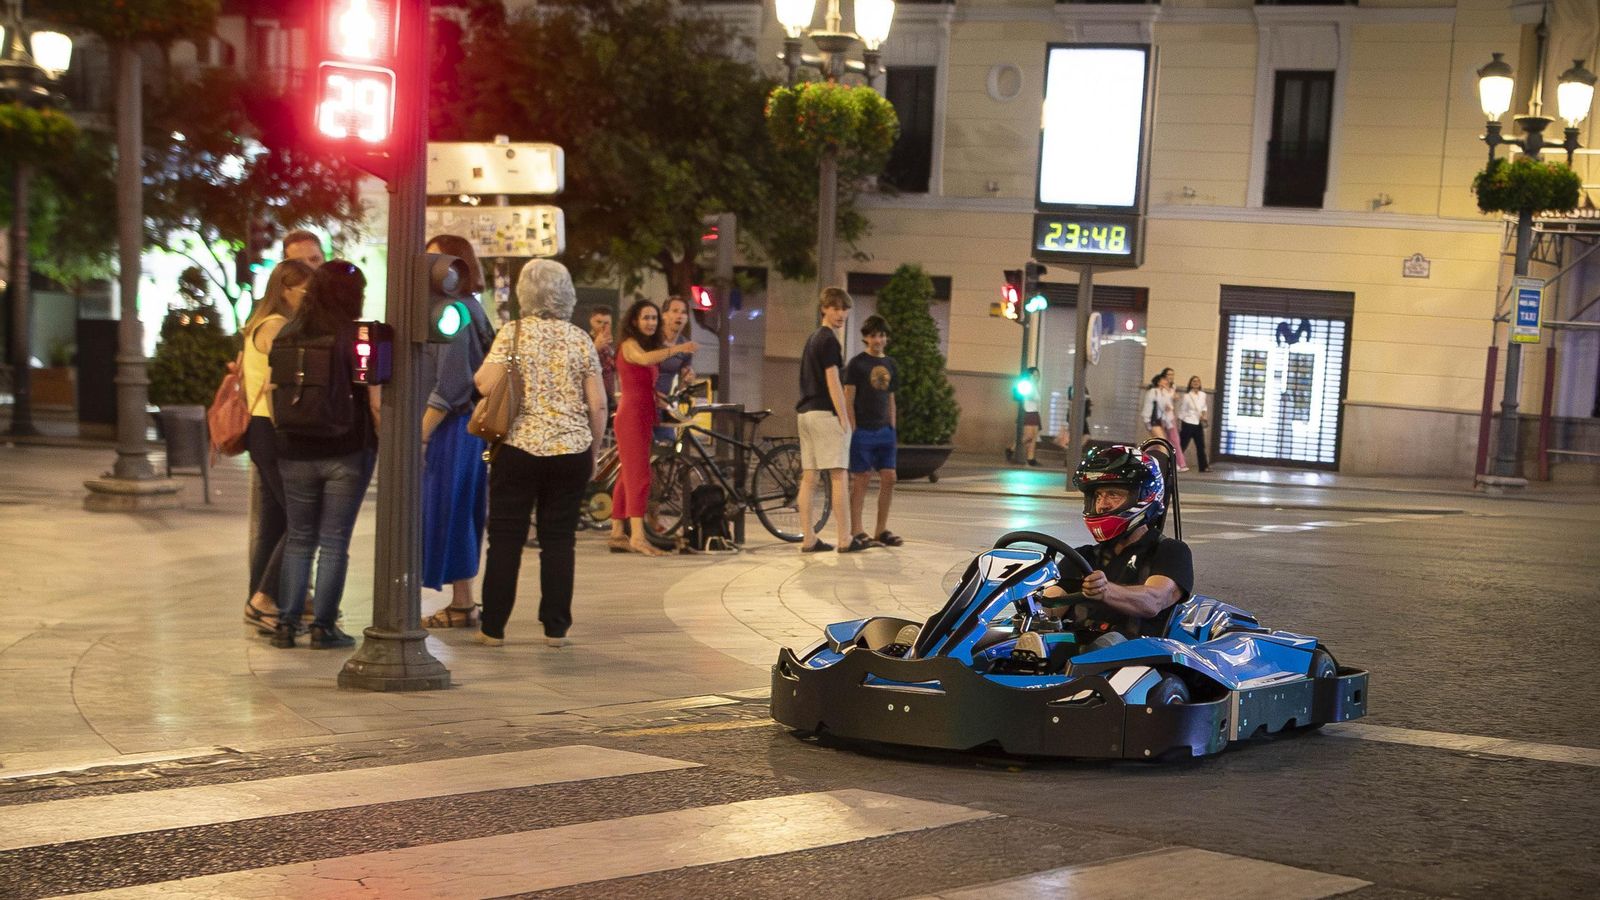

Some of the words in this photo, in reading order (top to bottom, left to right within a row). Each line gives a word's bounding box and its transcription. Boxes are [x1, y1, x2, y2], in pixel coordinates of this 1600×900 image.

[319, 75, 388, 141] 29
[1044, 222, 1126, 251] 23:48
[997, 563, 1023, 578] 1
